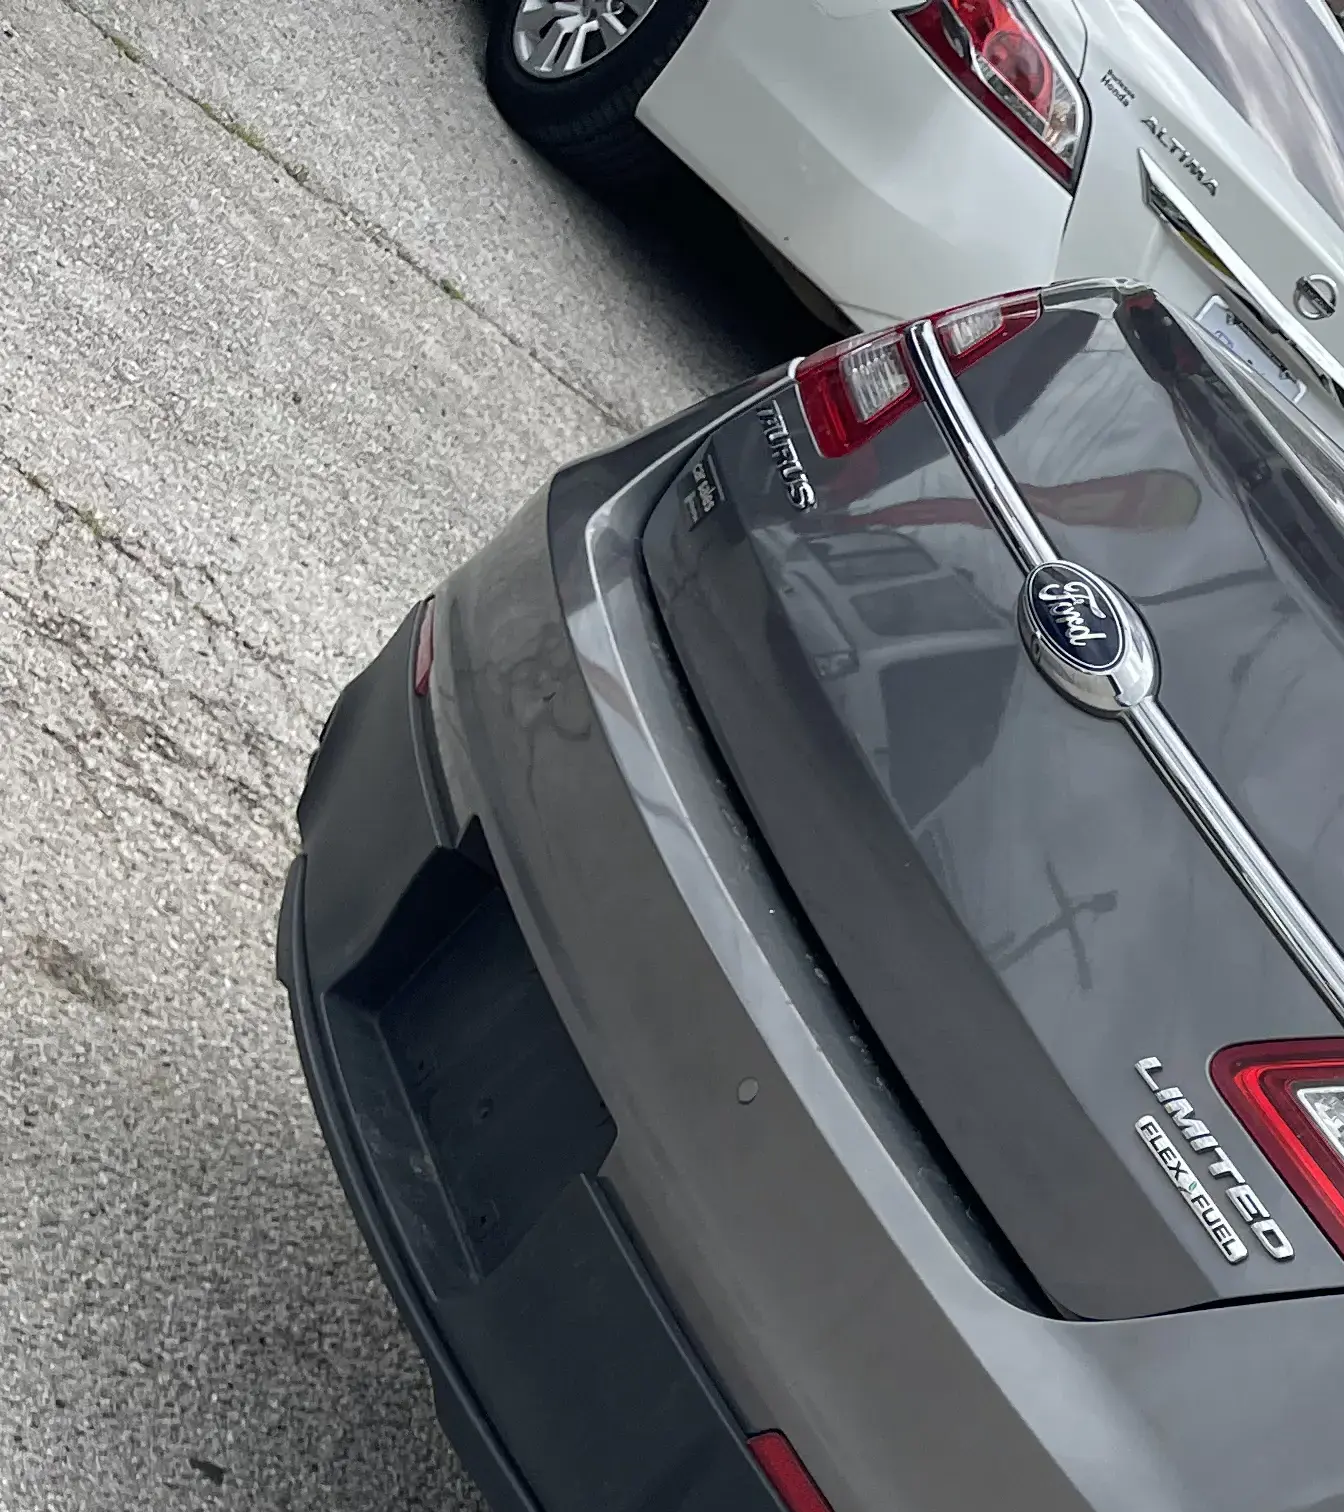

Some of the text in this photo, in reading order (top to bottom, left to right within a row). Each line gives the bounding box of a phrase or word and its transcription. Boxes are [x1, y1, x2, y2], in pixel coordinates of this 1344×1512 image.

[1100, 74, 1129, 107] Honda
[1140, 116, 1218, 196] ALTIMA
[756, 399, 816, 511] TAURUS
[1038, 581, 1107, 646] Ford
[1134, 1056, 1296, 1260] LIMITED
[1140, 1121, 1237, 1256] FLEX FUEL
